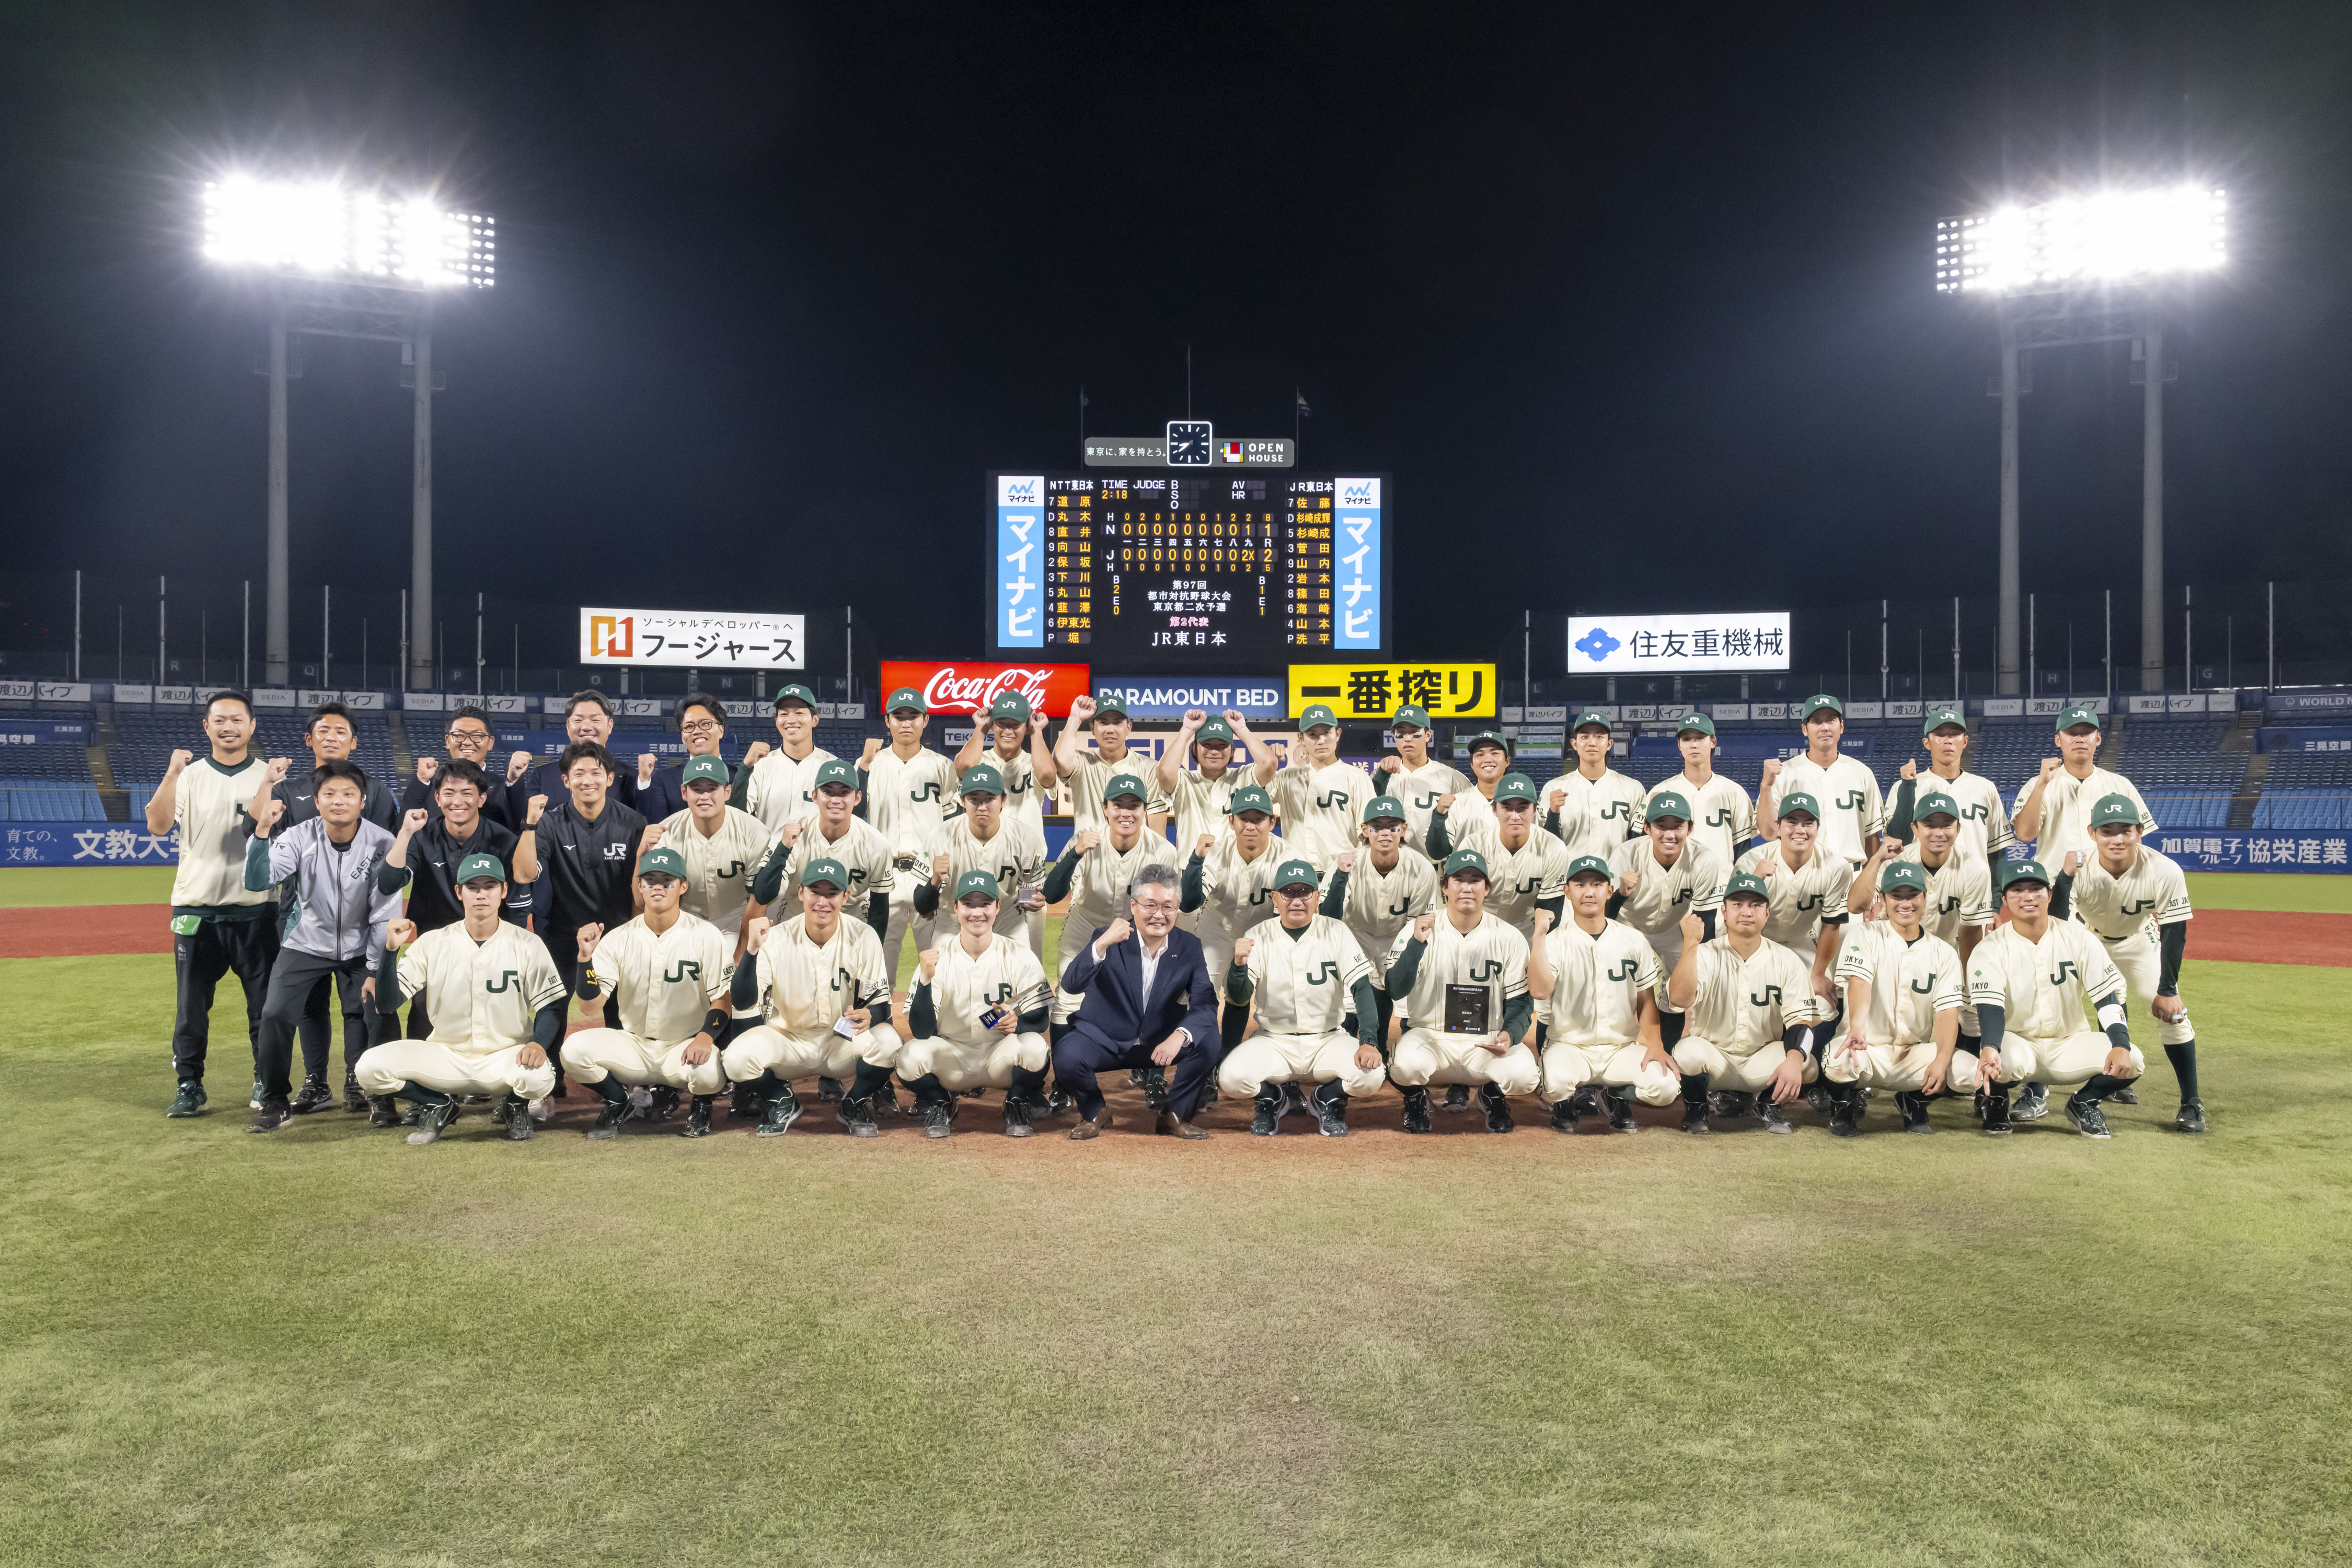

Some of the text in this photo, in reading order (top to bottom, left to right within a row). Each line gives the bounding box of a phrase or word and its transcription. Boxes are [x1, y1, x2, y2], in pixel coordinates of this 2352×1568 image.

[1086, 447, 1166, 457] 東京に、家を持とう。
[1248, 443, 1283, 452] OPEN
[1249, 454, 1283, 463] HOUSE
[1050, 479, 1093, 491] NTT東日本
[1101, 480, 1245, 489] TIME JUDGE B AV
[1289, 481, 1333, 492] JR東日本
[1102, 489, 1127, 499] 2:18
[1171, 490, 1246, 500] S HR
[1048, 497, 1054, 506] 7
[1288, 498, 1294, 508] 7
[1048, 512, 1055, 521] D
[1288, 514, 1294, 523] D
[1048, 527, 1055, 536] 8
[1106, 523, 1271, 537] N 0 0 0 0 0 0 0 0 1 1
[1288, 528, 1294, 538] 5
[1048, 542, 1054, 551] 9
[1288, 544, 1294, 553] 3
[1106, 550, 1114, 560] J
[1123, 548, 1131, 560] 0
[1138, 548, 1146, 561] 0
[1153, 548, 1161, 561] 0
[1168, 548, 1177, 561] 0
[1183, 549, 1192, 561] 0
[1198, 549, 1207, 561] 0
[1214, 549, 1222, 561] 0
[1229, 549, 1237, 561] 0
[1263, 548, 1272, 562] 2
[1048, 557, 1055, 567] 2
[1288, 559, 1294, 568] 9
[1005, 515, 1037, 637] マイナビ
[1048, 572, 1055, 582] 3
[1287, 574, 1294, 583] 2
[1342, 517, 1374, 639] マイナビ
[1172, 580, 1207, 590] 第97回
[1048, 587, 1054, 597] 5
[1147, 591, 1231, 601] 都市対抗野球大会
[1288, 589, 1294, 598] 8
[1048, 603, 1054, 612] 4
[1152, 602, 1226, 612] 東京都二次予選
[1287, 604, 1294, 613] 6
[1048, 617, 1091, 628] 6 伊東光
[1169, 616, 1209, 627] 第2代表
[1288, 619, 1293, 628] 4
[1048, 633, 1054, 642] P
[1152, 631, 1227, 647] JR東日本
[1287, 635, 1294, 643] P
[642, 632, 796, 663] フージャース
[1629, 628, 1784, 659] 住友重機械
[1301, 669, 1482, 713] 一番搾り
[1236, 688, 1278, 706] BED
[2299, 697, 2344, 706] WORLD
[2140, 698, 2194, 709] 渡辺パイプ
[1310, 710, 1324, 719] JR
[1628, 707, 1687, 719] 渡辺パイプ
[696, 763, 712, 771] JR
[1316, 790, 1349, 812] JR
[1601, 801, 1632, 824] JR
[2105, 804, 2123, 813] JR
[6, 829, 57, 844] 育ての、
[603, 843, 627, 856] JR
[2161, 837, 2243, 855] 加賀電子
[2246, 837, 2348, 864] 協栄産業
[6, 846, 45, 861] 文教。
[651, 855, 668, 864] JR
[2198, 854, 2243, 864] グループ
[351, 854, 373, 880] EAST
[472, 860, 490, 869] JR
[914, 859, 930, 873] OKYO
[2016, 865, 2034, 873] JR
[1739, 880, 1755, 889] JR
[1844, 955, 1864, 965] OKYO
[664, 960, 702, 983] JR
[722, 965, 735, 976] EAST
[1608, 959, 1640, 983] JR
[548, 975, 559, 986] EAST
